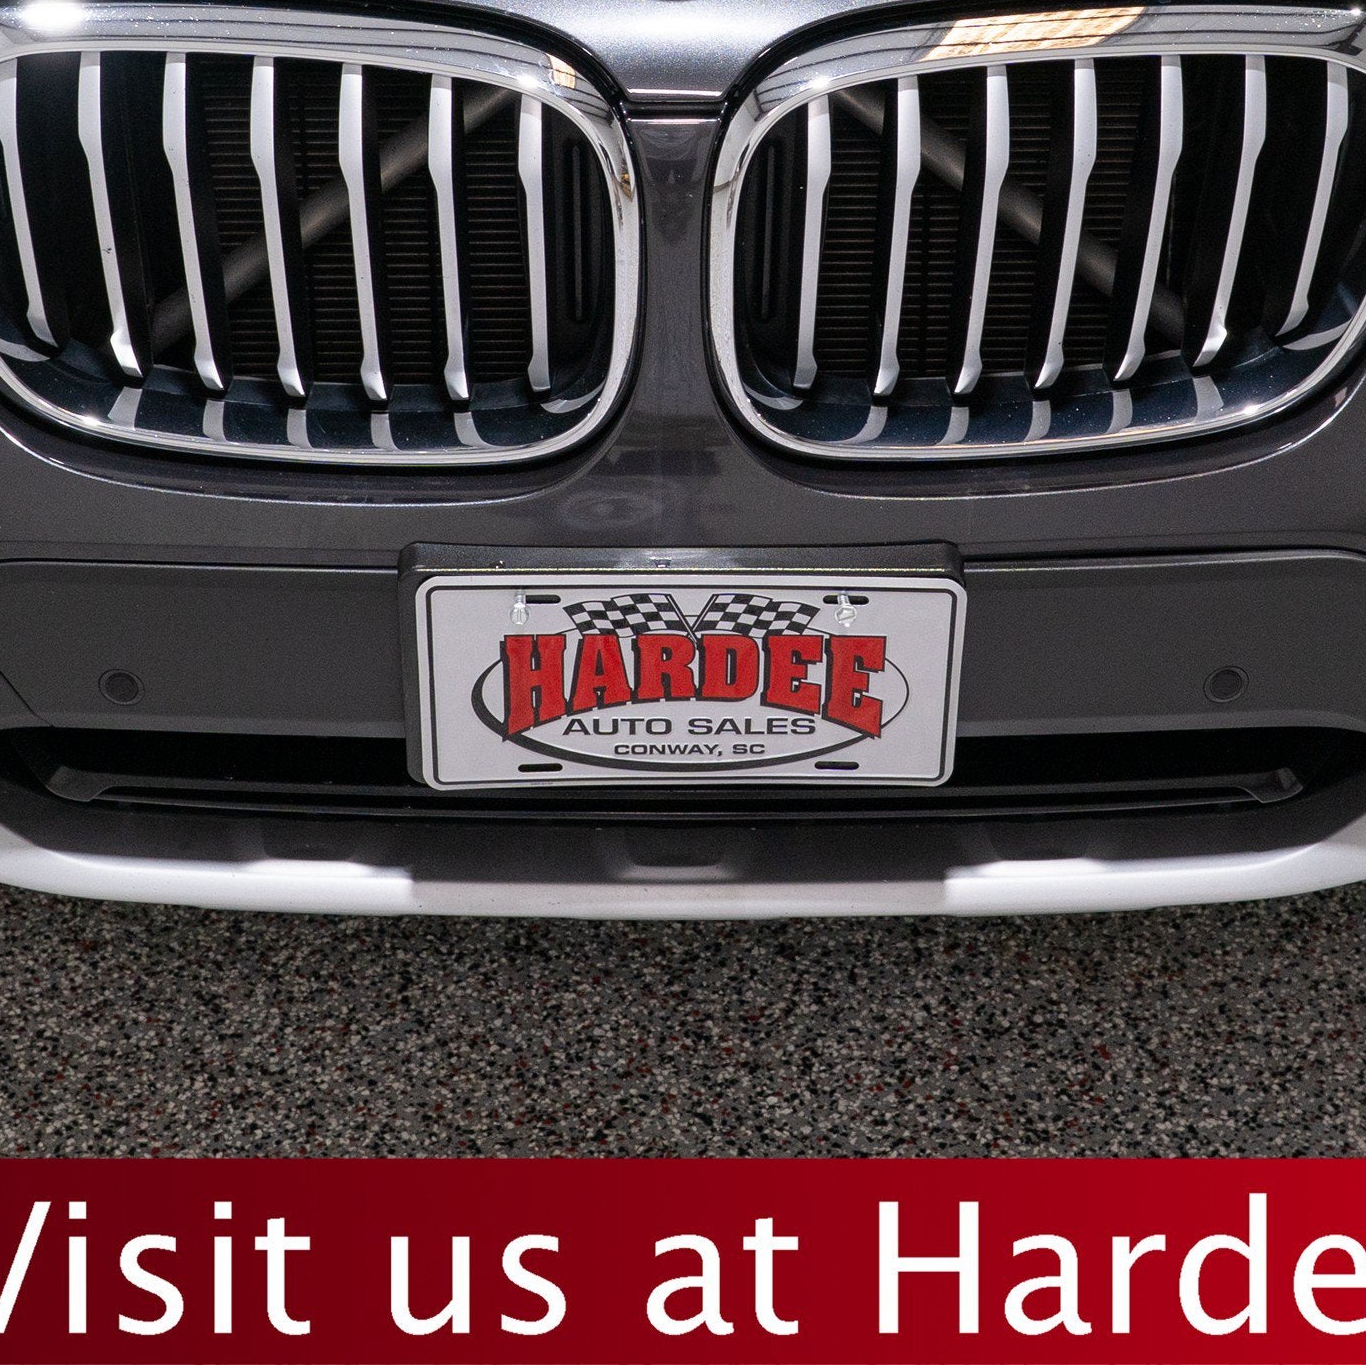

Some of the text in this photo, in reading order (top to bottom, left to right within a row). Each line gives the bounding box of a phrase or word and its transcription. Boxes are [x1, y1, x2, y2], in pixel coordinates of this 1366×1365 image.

[500, 634, 887, 741] HARDEE
[562, 716, 817, 736] AUTO SALES
[613, 742, 766, 757] CONWAY, SC
